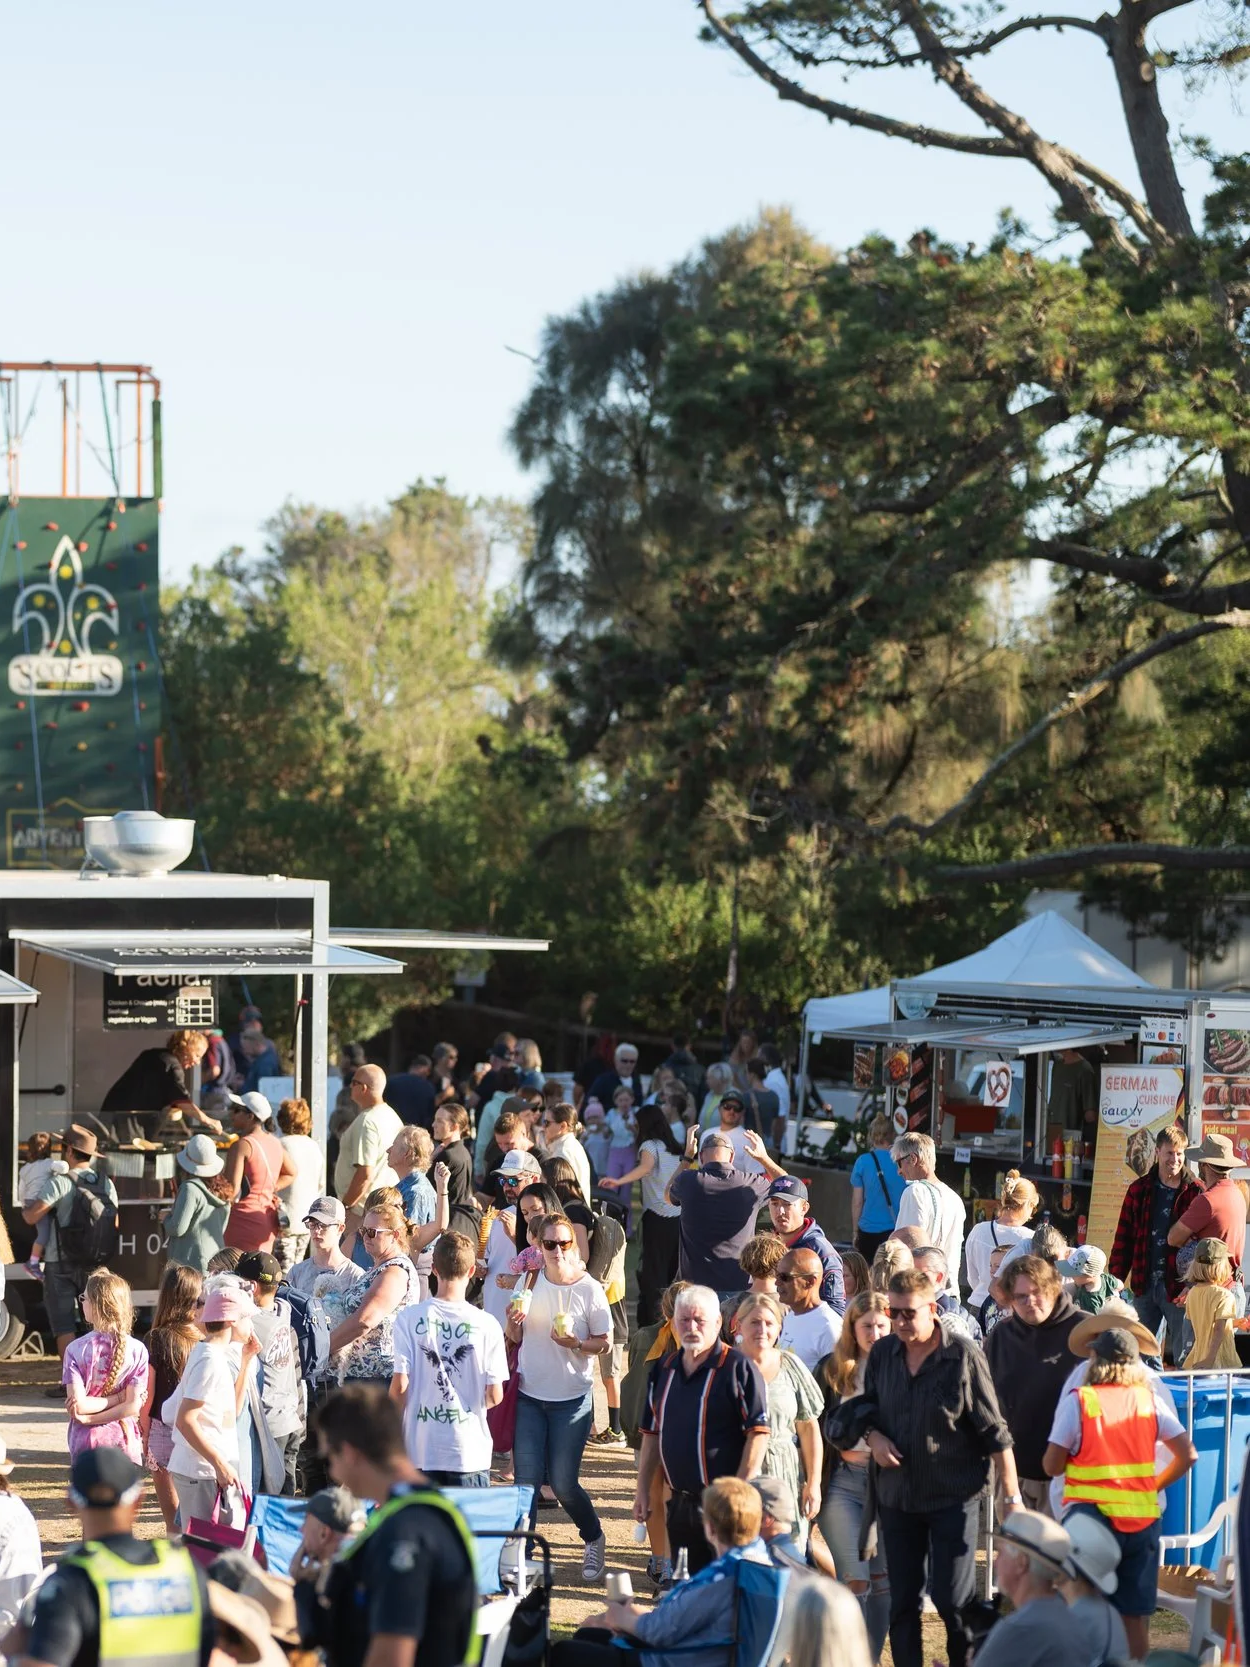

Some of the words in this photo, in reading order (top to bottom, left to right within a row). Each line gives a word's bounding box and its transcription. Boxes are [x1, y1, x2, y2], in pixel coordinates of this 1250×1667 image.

[1145, 1031, 1156, 1040] VISA
[1105, 1075, 1158, 1092] GERMAN
[1138, 1094, 1176, 1106] CUISINE
[1204, 1124, 1219, 1135] kids
[1220, 1124, 1238, 1135] meal
